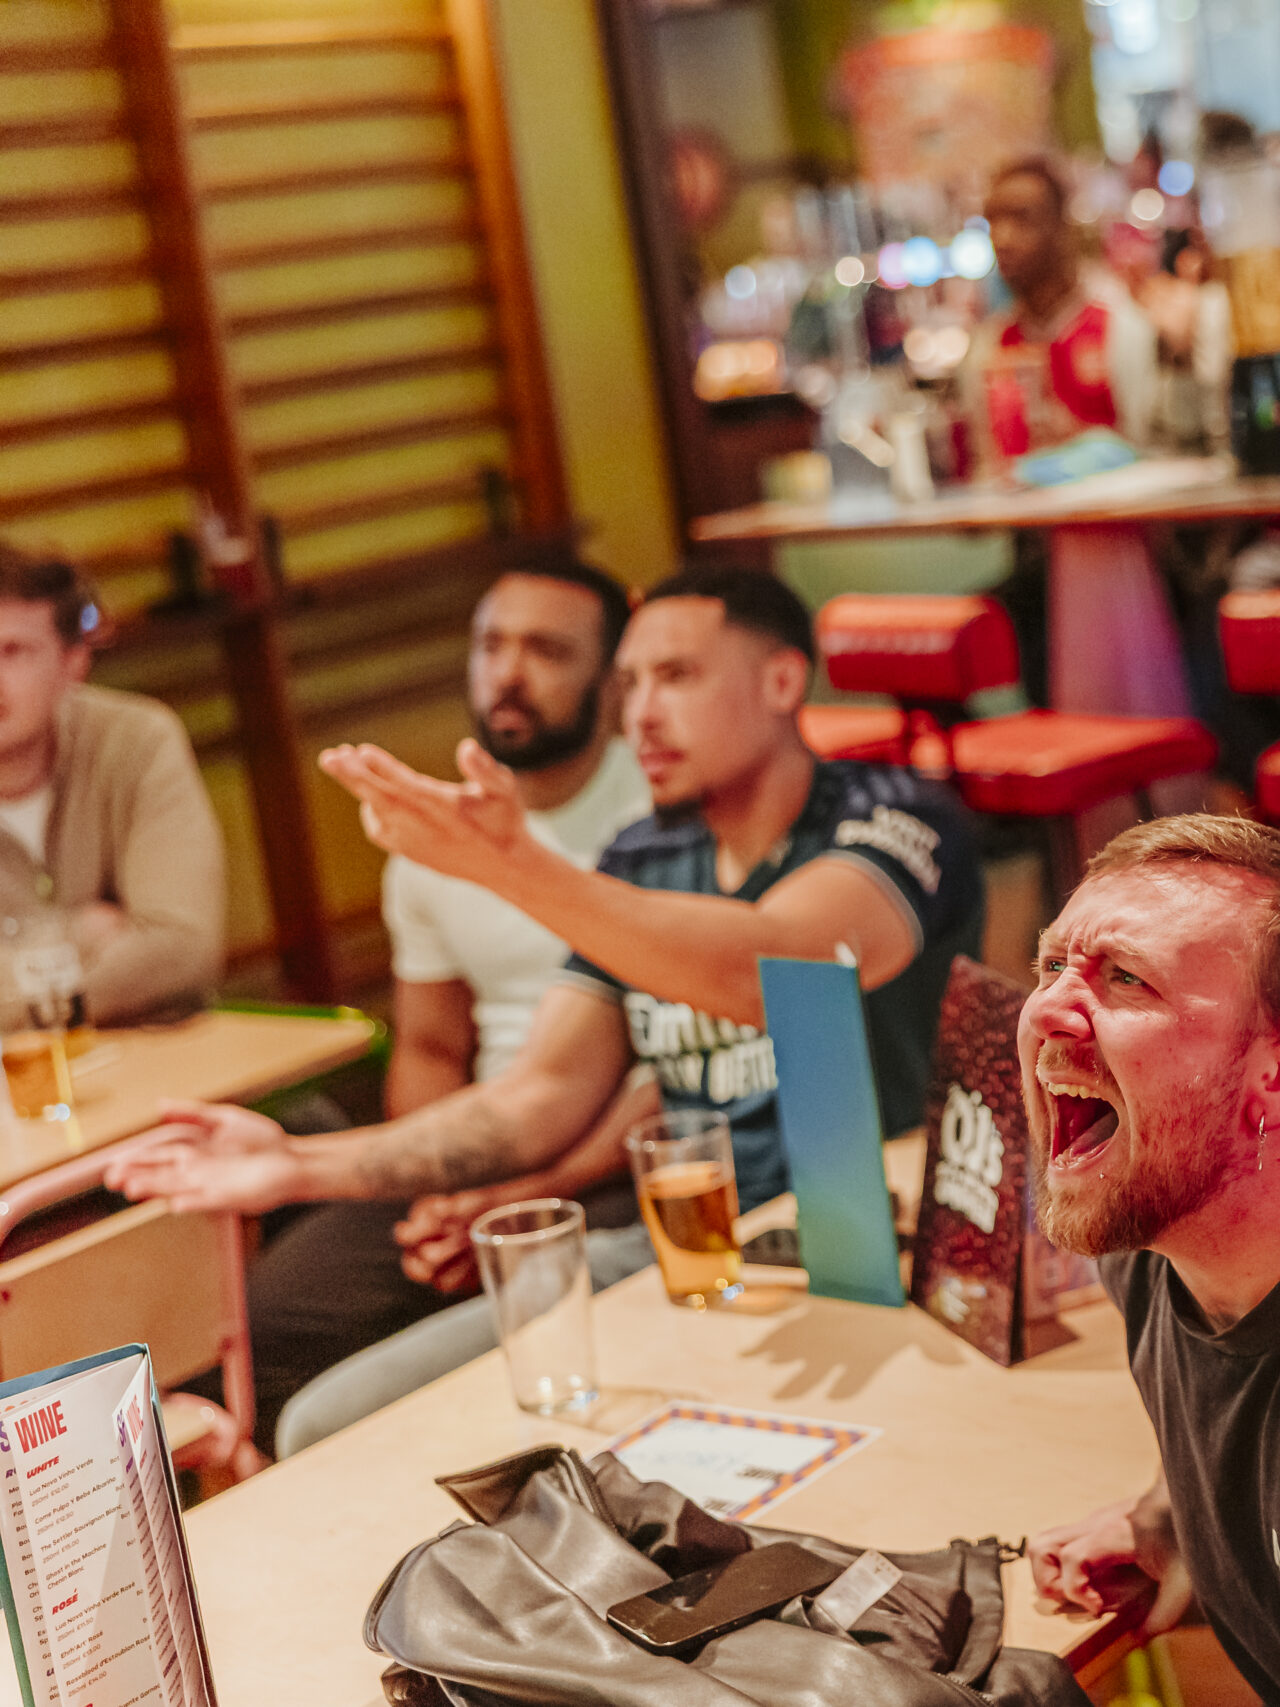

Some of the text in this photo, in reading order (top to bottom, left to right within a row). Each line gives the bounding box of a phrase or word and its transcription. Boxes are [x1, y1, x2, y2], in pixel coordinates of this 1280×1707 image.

[14, 1400, 67, 1454] WINE
[26, 1456, 60, 1479] WHITE
[73, 1513, 105, 1534] Sauvignon
[71, 1558, 81, 1566] the
[82, 1543, 107, 1560] Machine
[52, 1587, 79, 1615] ROSÉ
[101, 1591, 119, 1604] Verde
